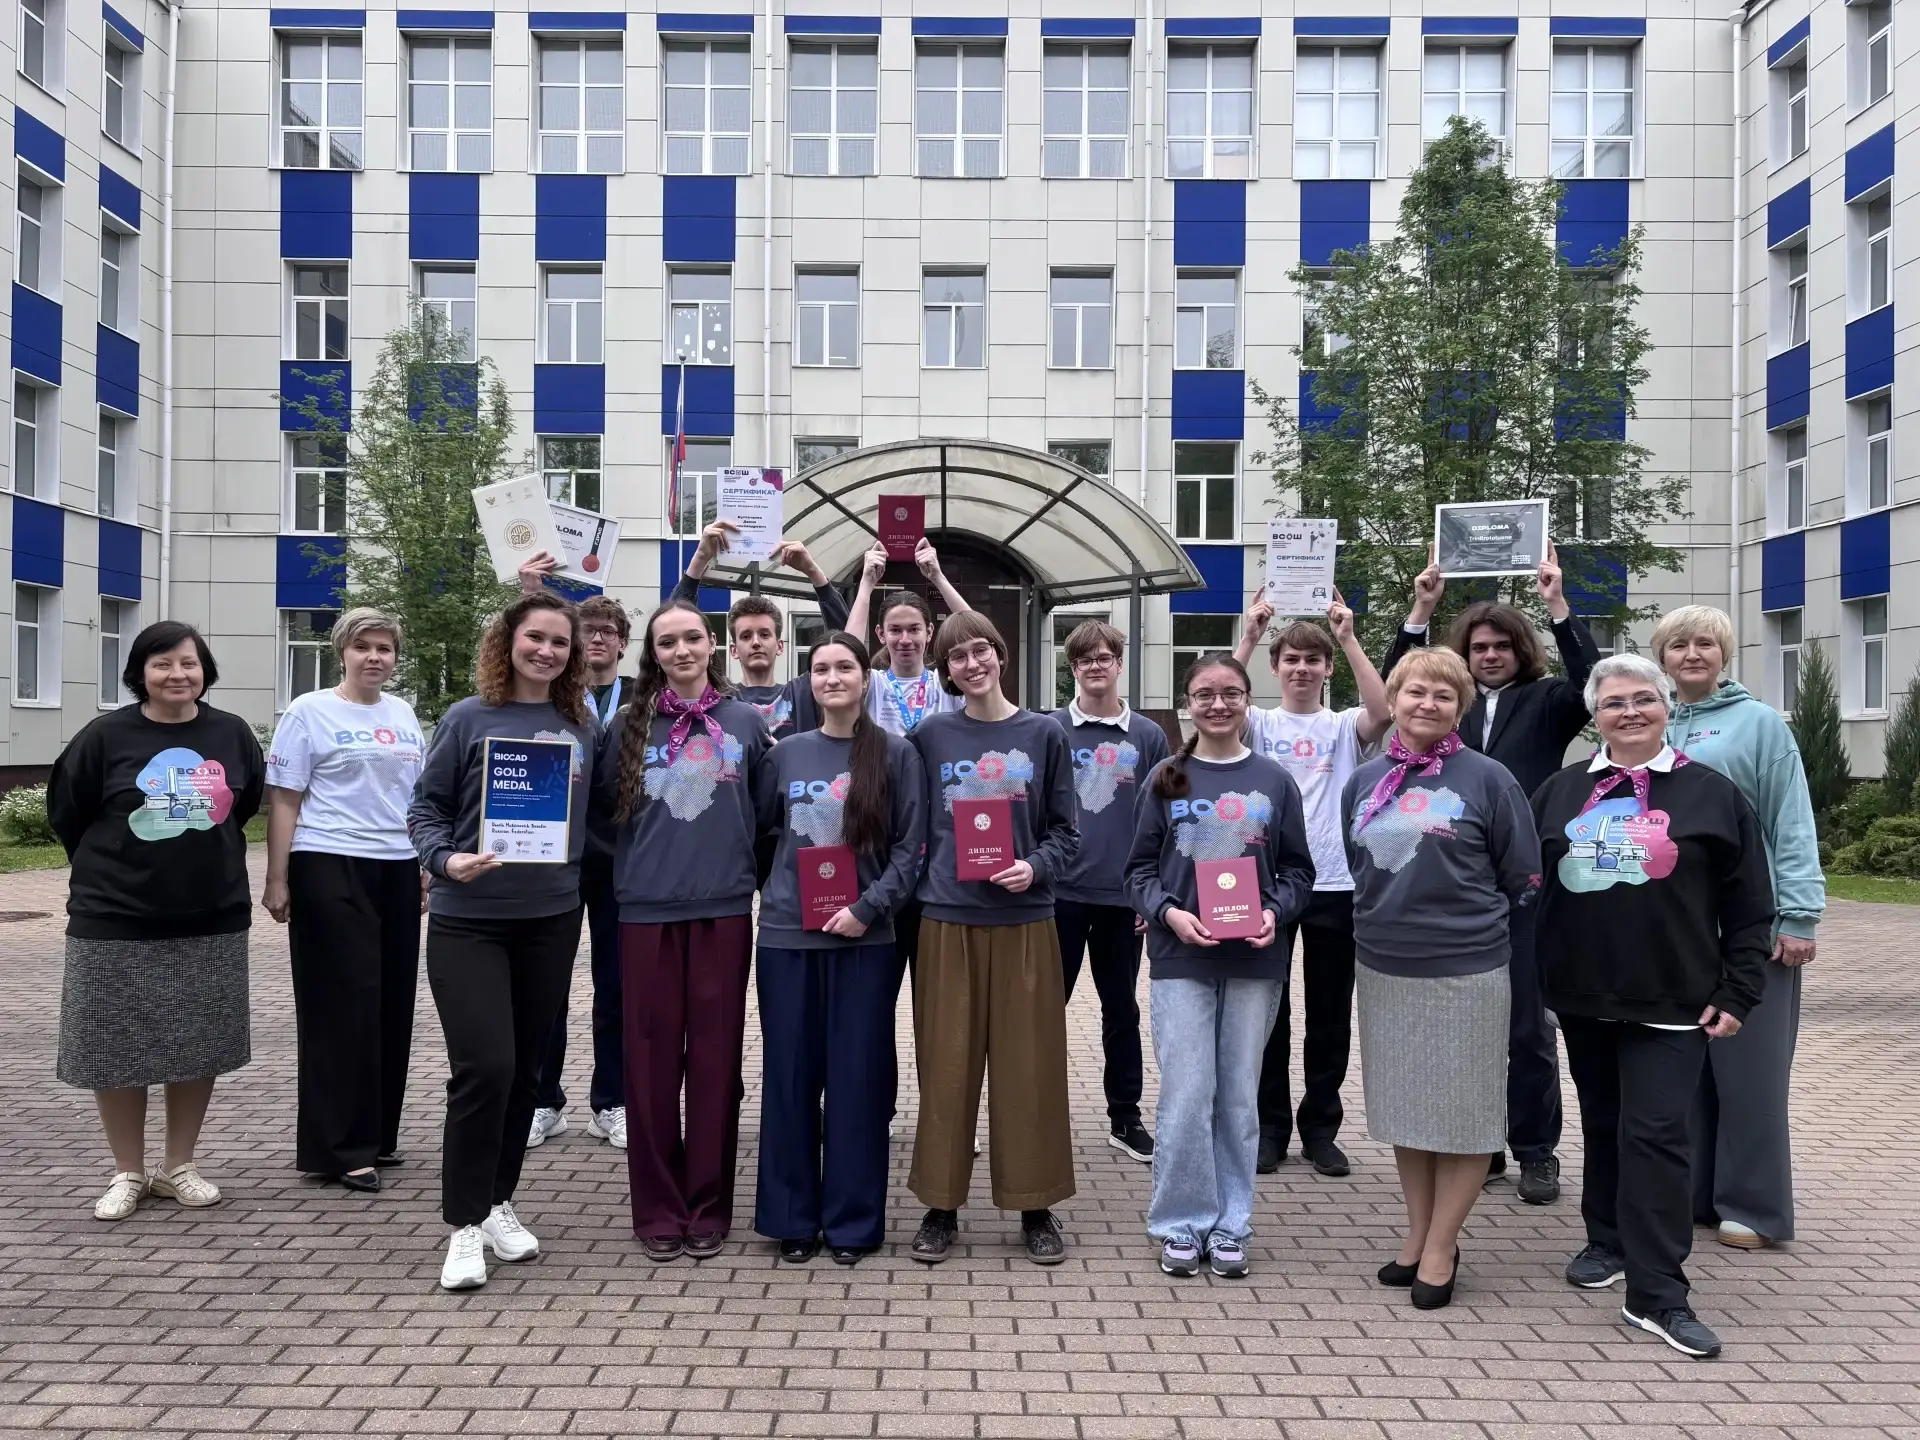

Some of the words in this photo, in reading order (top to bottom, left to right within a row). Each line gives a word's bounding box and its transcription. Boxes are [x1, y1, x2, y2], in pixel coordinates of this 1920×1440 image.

[722, 488, 776, 496] СЕРТИФИКАТ
[556, 525, 583, 537] LOMA
[494, 752, 528, 762] BIOCAD
[176, 767, 221, 776] ВСОШ
[493, 767, 528, 778] GOLD
[492, 780, 534, 791] MEDAL
[1611, 815, 1665, 825] ВСОШ
[968, 847, 1002, 855] ДИПЛОМ
[812, 894, 847, 904] ДИПЛОМ
[1212, 904, 1249, 913] ДИПЛОМ
